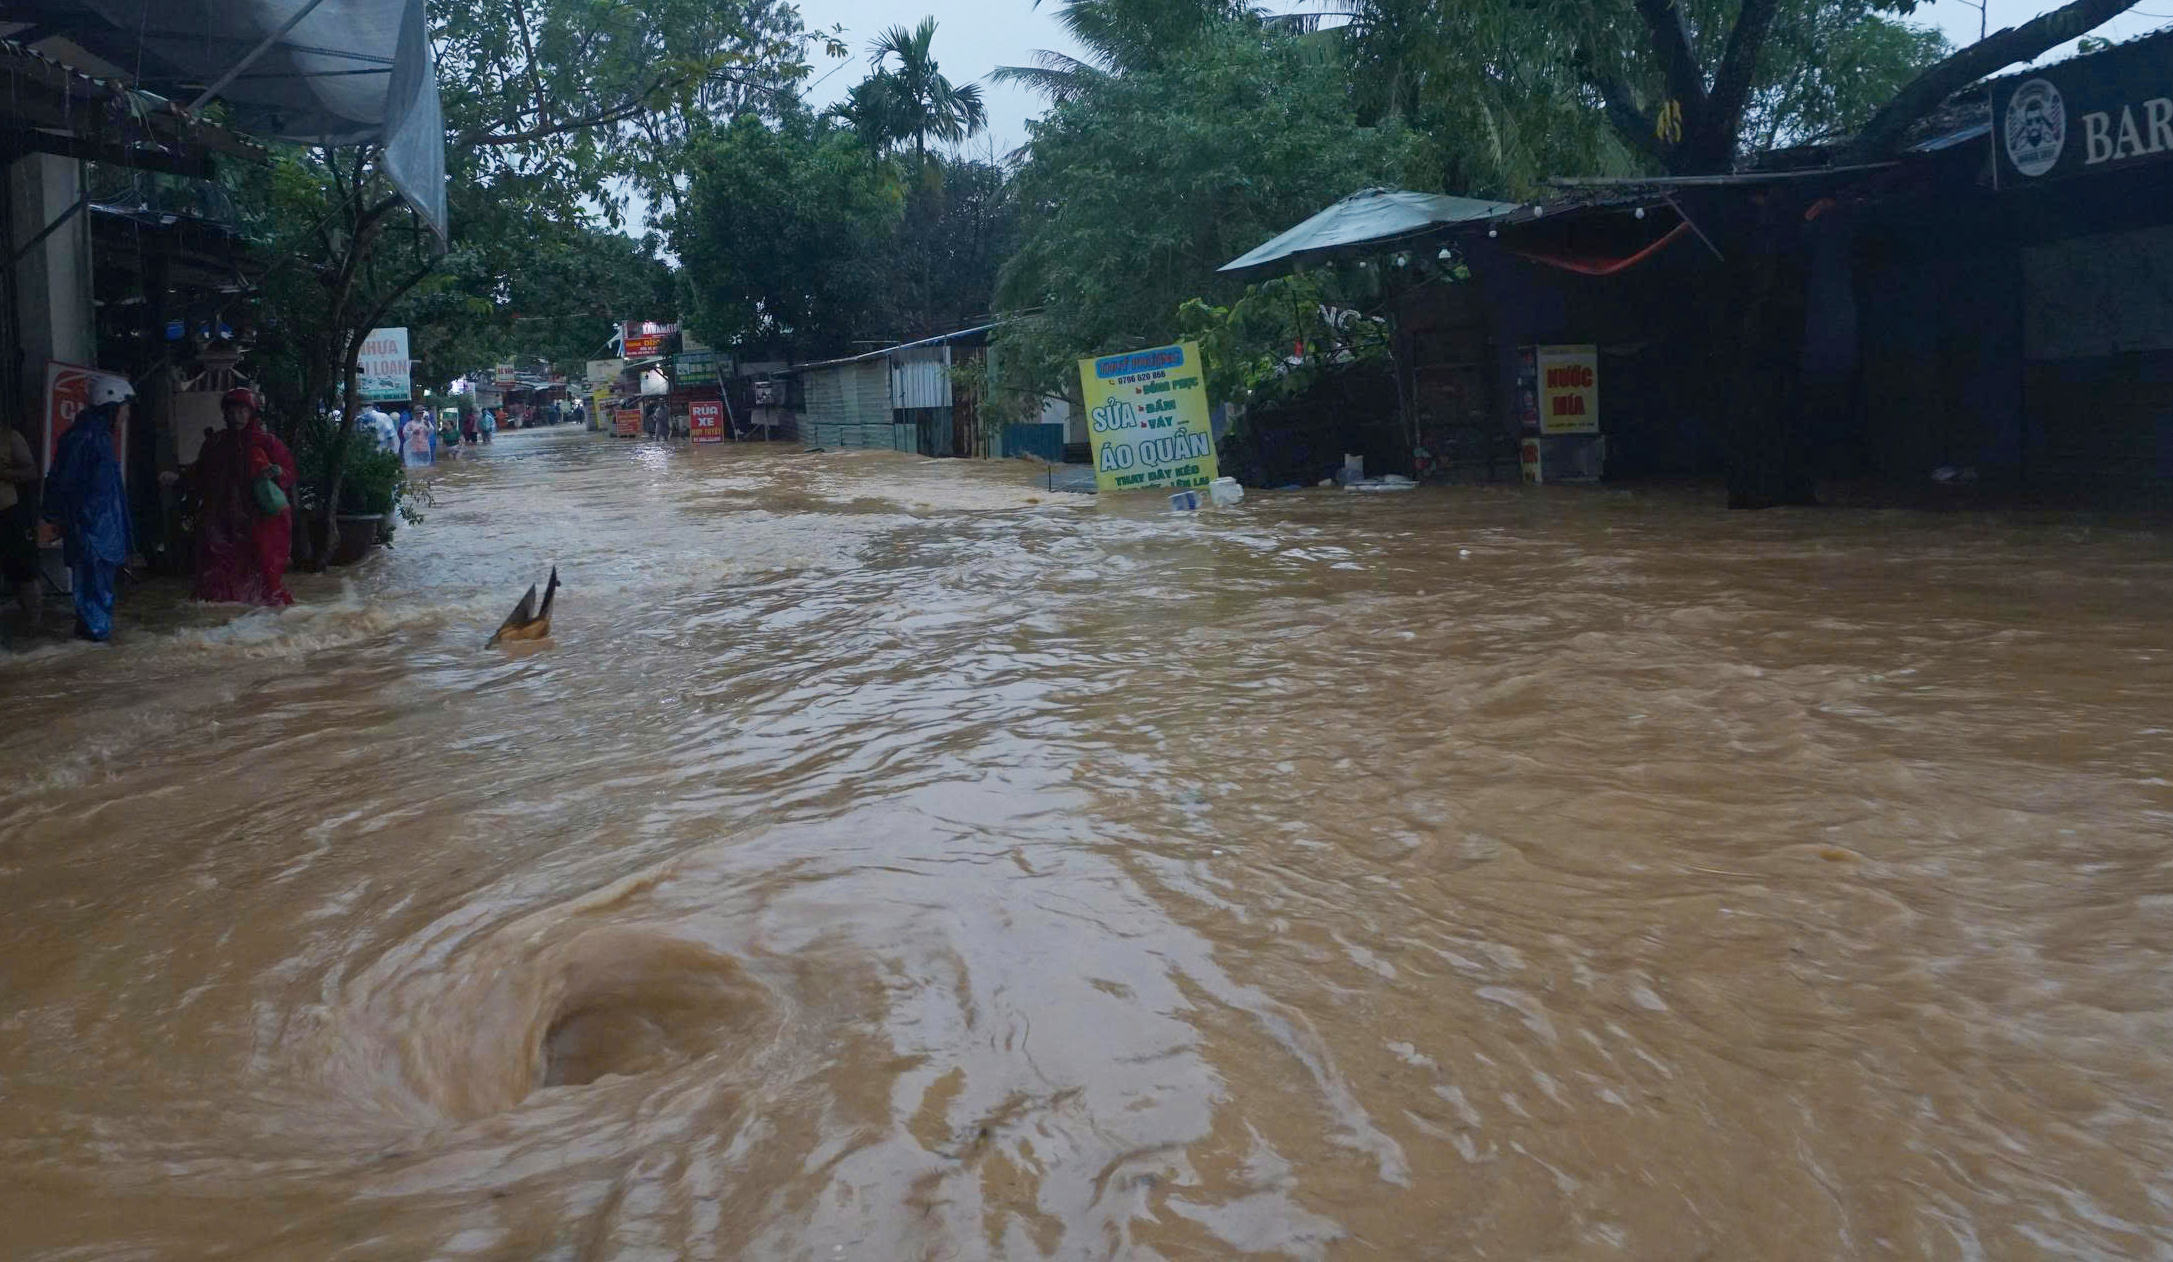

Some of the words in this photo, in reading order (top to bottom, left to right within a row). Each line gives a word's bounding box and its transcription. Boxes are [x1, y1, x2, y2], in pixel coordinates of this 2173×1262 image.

[2082, 98, 2173, 165] BAR
[374, 359, 410, 375] LOAN
[1547, 364, 1593, 388] NƯỚC
[1092, 397, 1137, 432] SỬA
[1553, 393, 1586, 416] MÍA
[698, 417, 715, 427] XE
[1100, 442, 1134, 472] ÁO
[1139, 427, 1211, 468] QUẦN
[1115, 472, 1145, 487] THAY
[1148, 468, 1173, 481] DÂY
[1175, 464, 1200, 477] KÉO
